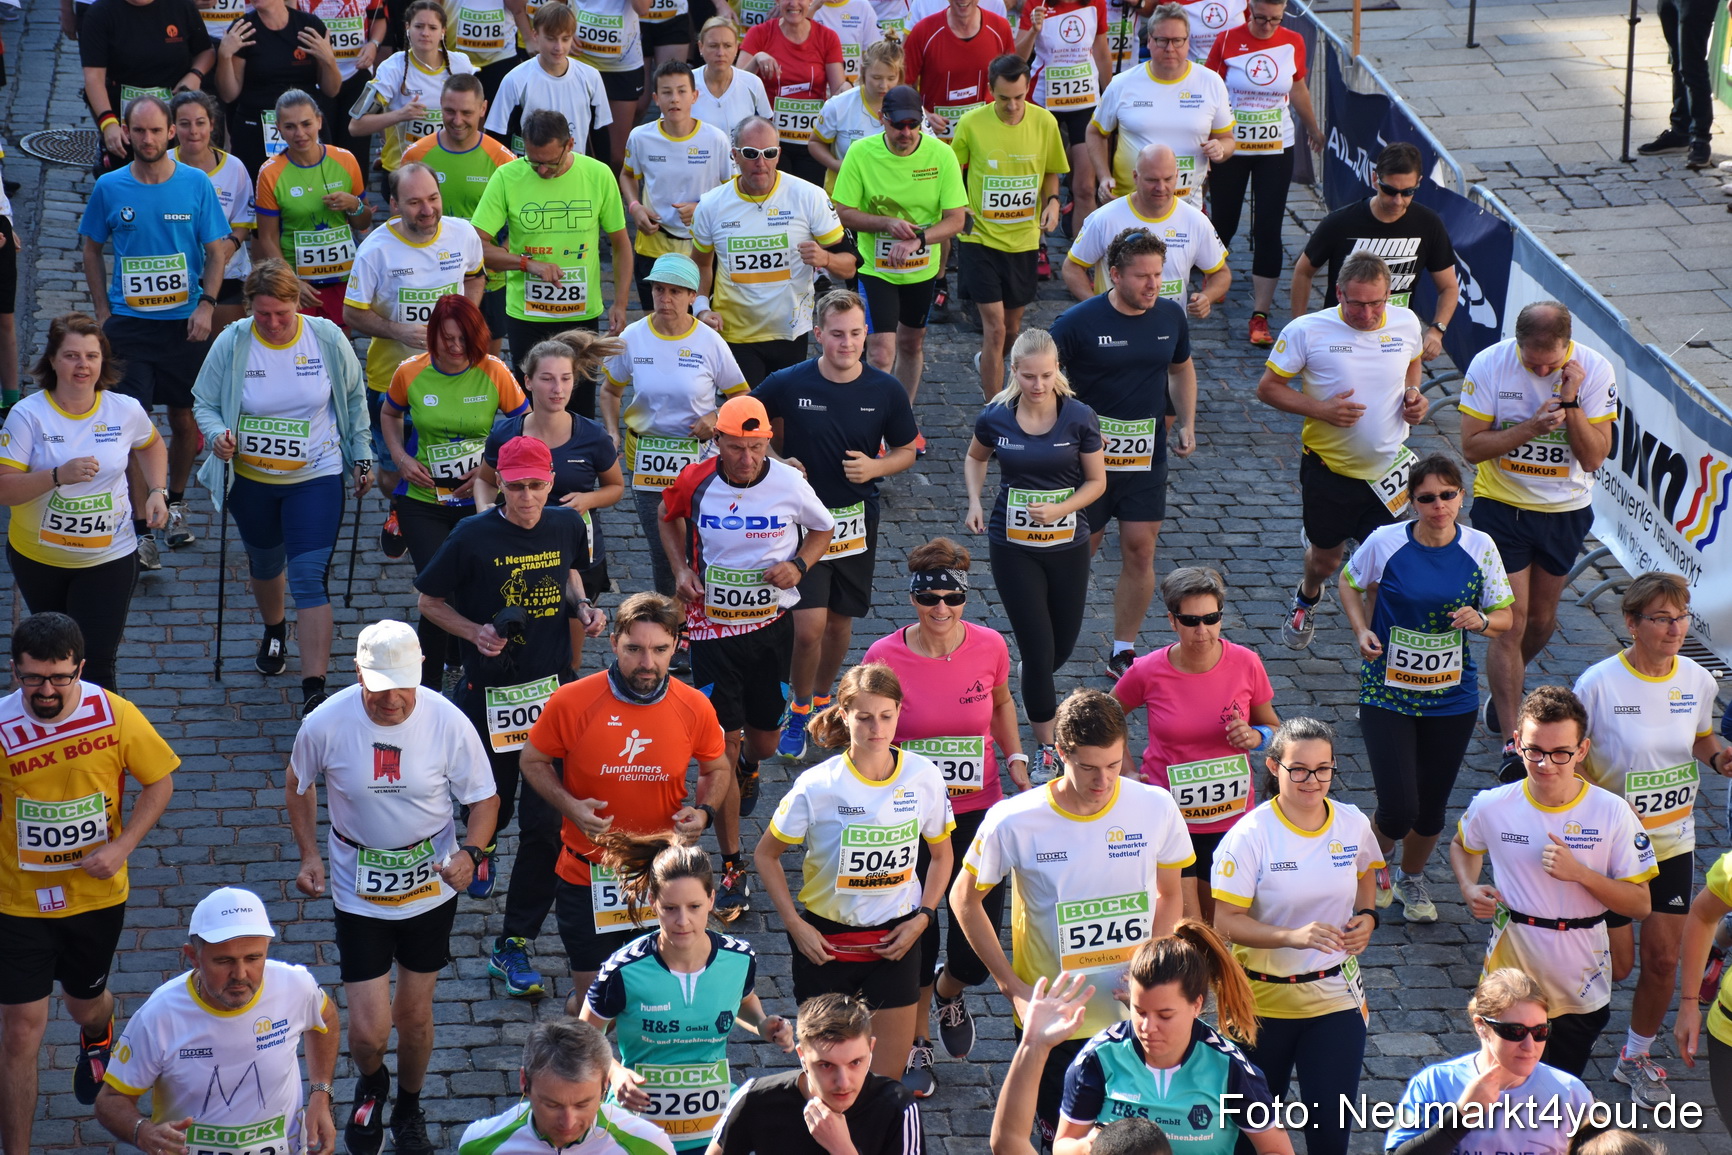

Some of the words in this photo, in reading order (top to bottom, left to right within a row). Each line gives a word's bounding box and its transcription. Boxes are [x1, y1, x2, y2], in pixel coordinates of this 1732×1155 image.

[463, 9, 501, 21] BOCK
[580, 13, 619, 26] BOCK
[462, 24, 501, 38] 5018
[579, 28, 618, 43] 5096
[463, 40, 499, 49] STEFANIE
[1050, 66, 1086, 78] BOCK
[1052, 80, 1090, 95] 5125
[1055, 95, 1088, 105] CLAUDIA
[780, 103, 820, 111] BOCK
[1238, 111, 1278, 122] BOCK
[1238, 126, 1278, 139] 5120
[688, 147, 698, 155] 20
[989, 177, 1034, 188] BOCK
[989, 192, 1031, 207] 5046
[768, 208, 778, 216] 20
[301, 231, 347, 245] BOCK
[732, 236, 782, 250] BOCK
[303, 244, 348, 263] 5151
[439, 251, 450, 259] 20
[127, 258, 179, 272] BOCK
[735, 252, 783, 271] 5282
[312, 263, 344, 274] JULITA
[130, 274, 181, 293] 5168
[403, 285, 452, 300] BOCK
[531, 285, 580, 301] 5228
[138, 295, 176, 306] STEFAN
[531, 303, 580, 312] WOLFGANG
[680, 349, 691, 357] 20
[296, 356, 307, 368] 20
[1499, 391, 1523, 399] BOCK
[94, 424, 106, 432] 20
[244, 420, 303, 434] BOCK
[246, 436, 300, 458] 5255
[641, 438, 694, 452] BOCK
[1511, 463, 1557, 476] MARKUS
[52, 494, 109, 512] BOCK
[49, 515, 106, 534] 5254
[1027, 533, 1055, 541] ANJA
[506, 551, 560, 564] Neumarkter
[1653, 518, 1703, 588] neumarkt
[713, 588, 771, 607] 5048
[712, 608, 771, 618] WOLFGANG
[721, 622, 759, 638] AVIA
[1396, 630, 1456, 650] BOCK
[1395, 649, 1453, 672] 5207
[1395, 672, 1452, 684] CORNELIA
[493, 682, 553, 701] BOCK
[1670, 690, 1681, 701] 20
[1614, 705, 1641, 713] BOCK
[1670, 700, 1697, 708] Neumarkter
[1670, 707, 1691, 715] Stadtlauf
[906, 739, 977, 754] BOCK
[9, 751, 58, 777] MAX
[63, 734, 120, 760] BÖGL
[600, 764, 661, 775] funrunners
[1180, 761, 1241, 783] BOCK
[619, 773, 669, 782] neumarkt
[1631, 767, 1691, 790] BOCK
[1180, 779, 1239, 806] 5131
[1634, 787, 1690, 814] 5280
[24, 797, 95, 819] BOCK
[838, 806, 865, 815] BOCK
[1185, 804, 1233, 819] SANDRA
[27, 820, 97, 848] 5099
[850, 822, 915, 845] BOCK
[1565, 823, 1581, 835] 20
[1107, 830, 1124, 843] 20
[1501, 832, 1529, 843] BOCK
[1564, 835, 1603, 844] Neumarkter
[1108, 841, 1148, 851] Neumarkter
[1329, 843, 1343, 854] 20
[43, 850, 83, 863] ADEM
[367, 843, 430, 870] BOCK
[849, 846, 911, 873] 5043
[1037, 852, 1067, 860] BOCK
[1108, 850, 1140, 859] Stadtlauf
[1270, 862, 1296, 870] BOCK
[366, 862, 429, 893] 5235
[221, 907, 253, 916] OLYMP
[1066, 894, 1141, 919] BOCK
[1069, 918, 1141, 950] 5246
[1079, 953, 1121, 965] Christian
[640, 1001, 671, 1013] hummel
[256, 1019, 272, 1034] 20
[642, 1018, 680, 1033] H&S
[685, 1025, 709, 1033] GmbH
[256, 1026, 290, 1043] Neumarkter
[256, 1037, 286, 1051] Stadtlauf
[180, 1047, 213, 1058] BOCK
[645, 1066, 720, 1086] BOCK
[646, 1090, 719, 1116] 5260
[664, 1120, 702, 1134] ALEX
[1155, 1116, 1181, 1126] GmbH
[195, 1123, 277, 1145] BOCK
